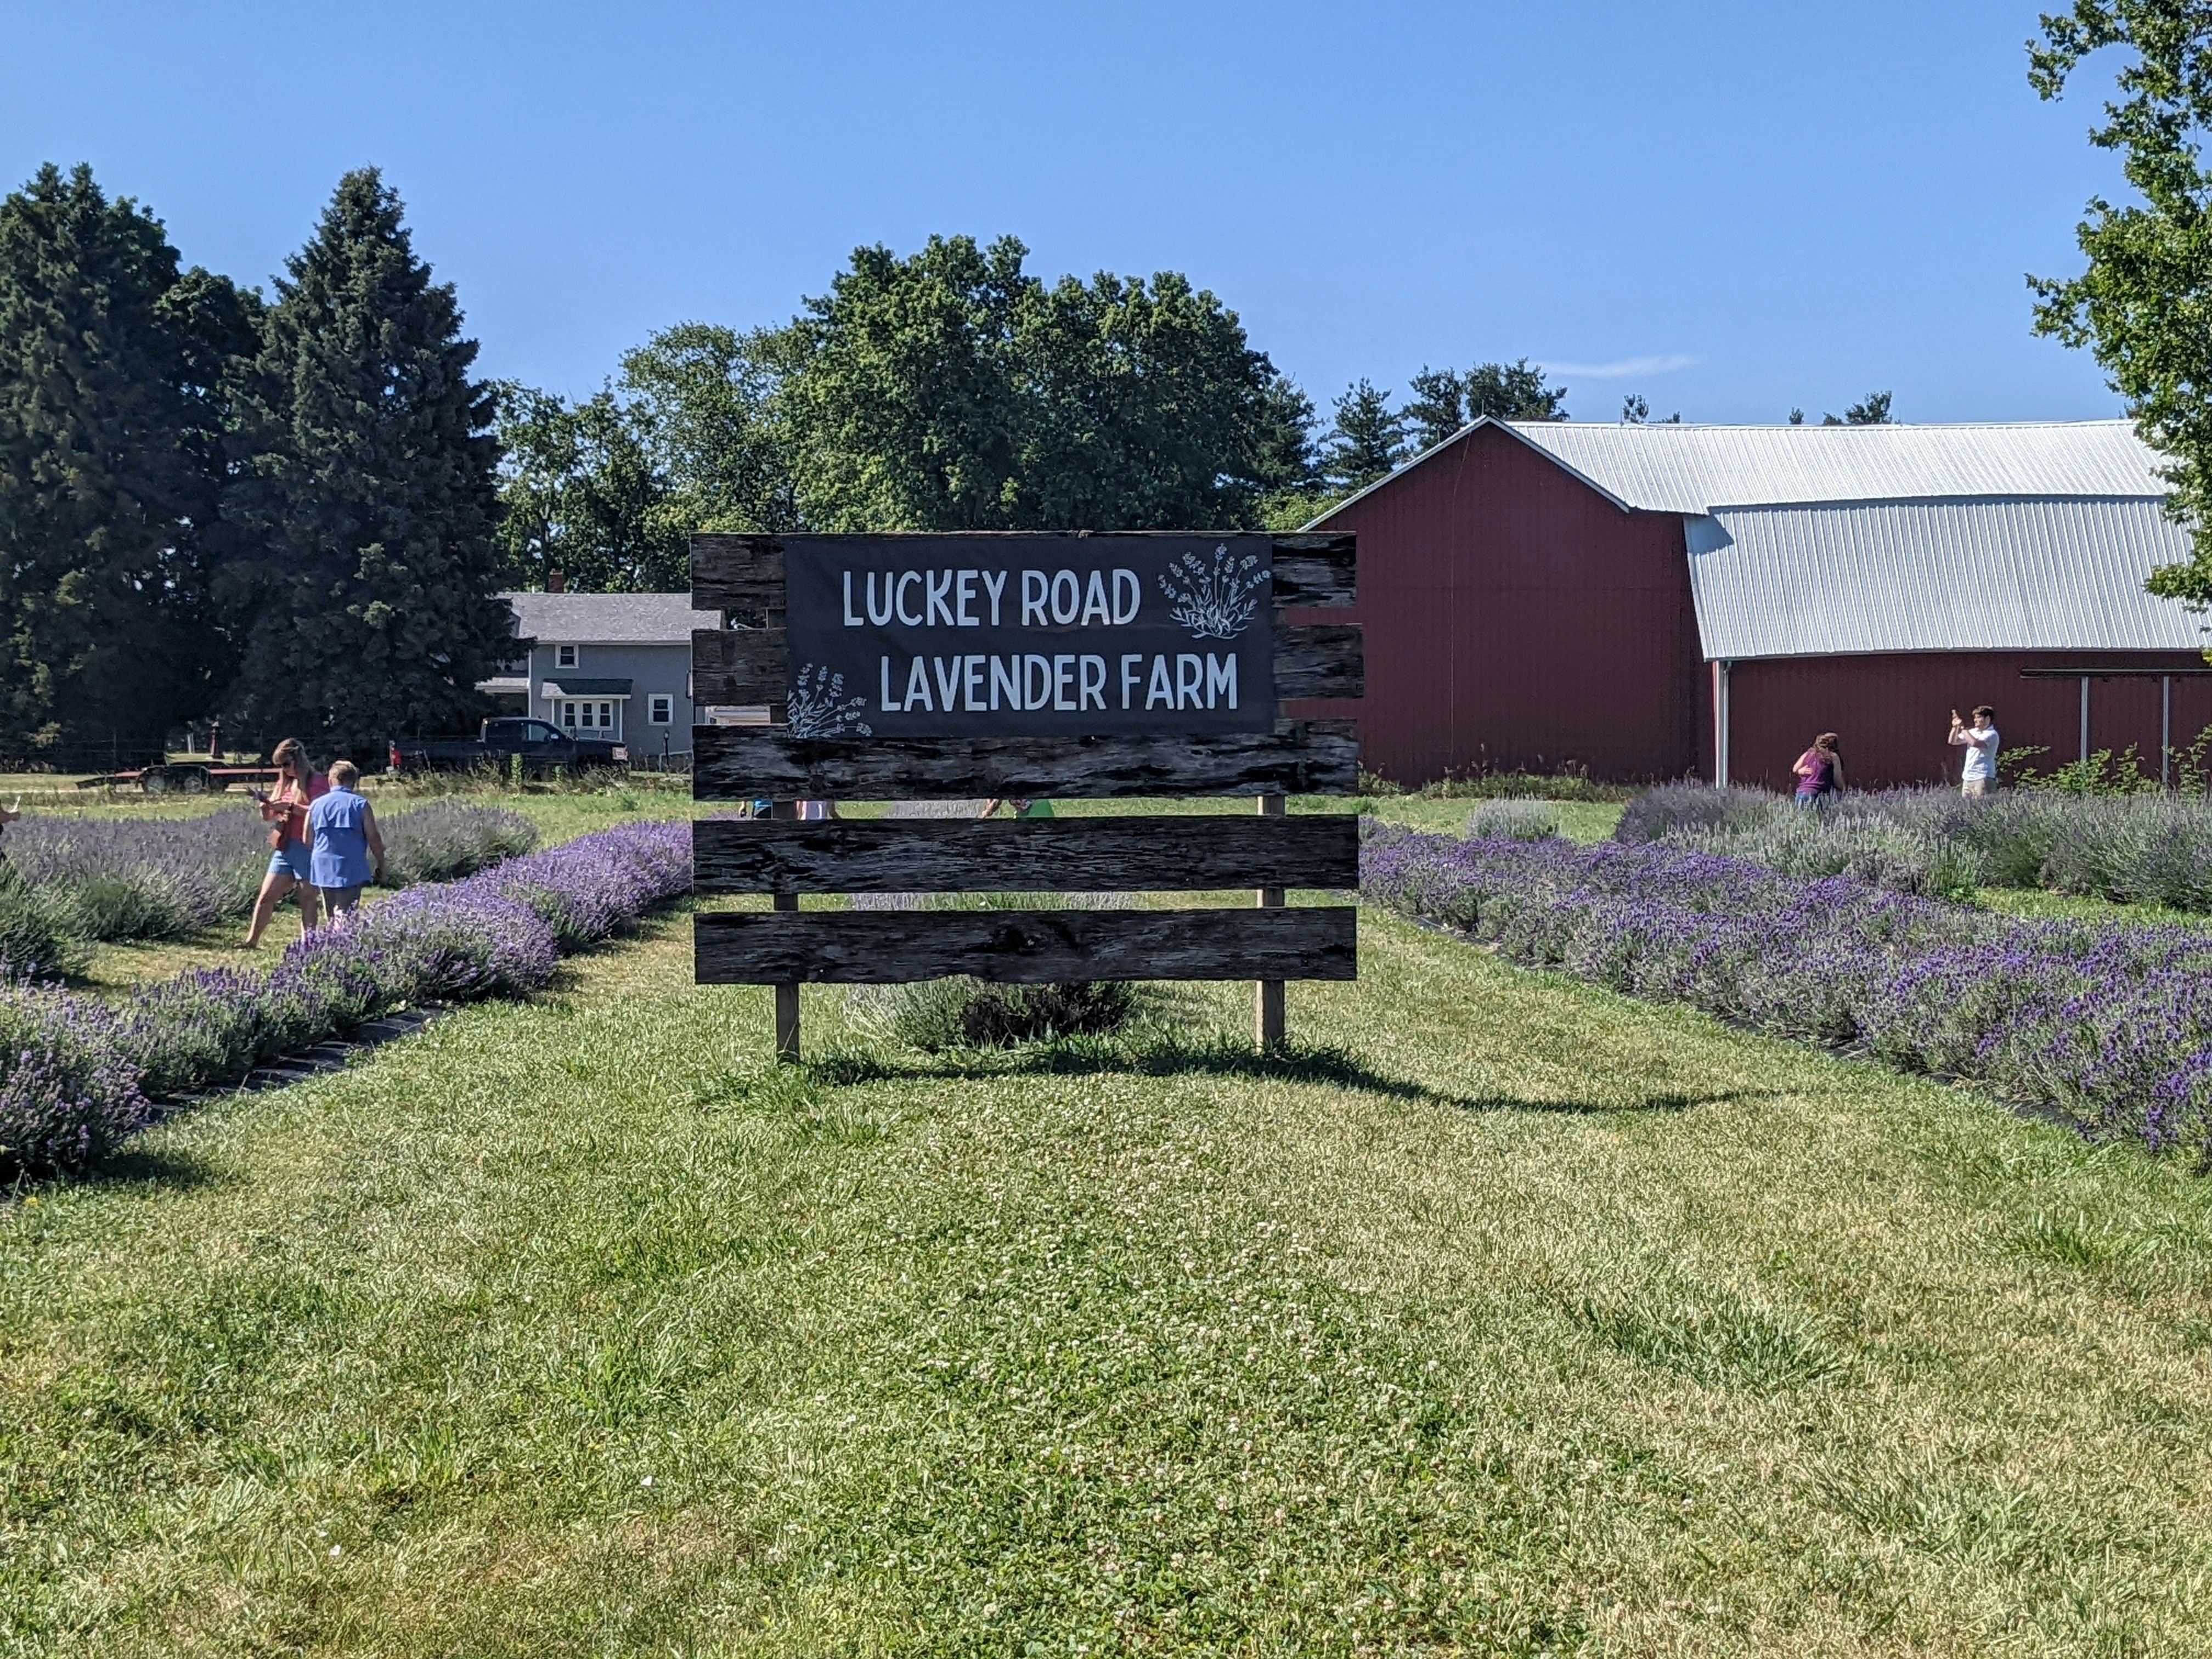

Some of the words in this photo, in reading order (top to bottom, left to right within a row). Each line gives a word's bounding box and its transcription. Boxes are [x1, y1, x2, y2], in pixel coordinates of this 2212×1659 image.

[844, 569, 1006, 625] LUCKEY
[1022, 569, 1140, 625] ROAD
[881, 654, 1105, 711] LAVENDER
[1121, 653, 1238, 711] FARM
